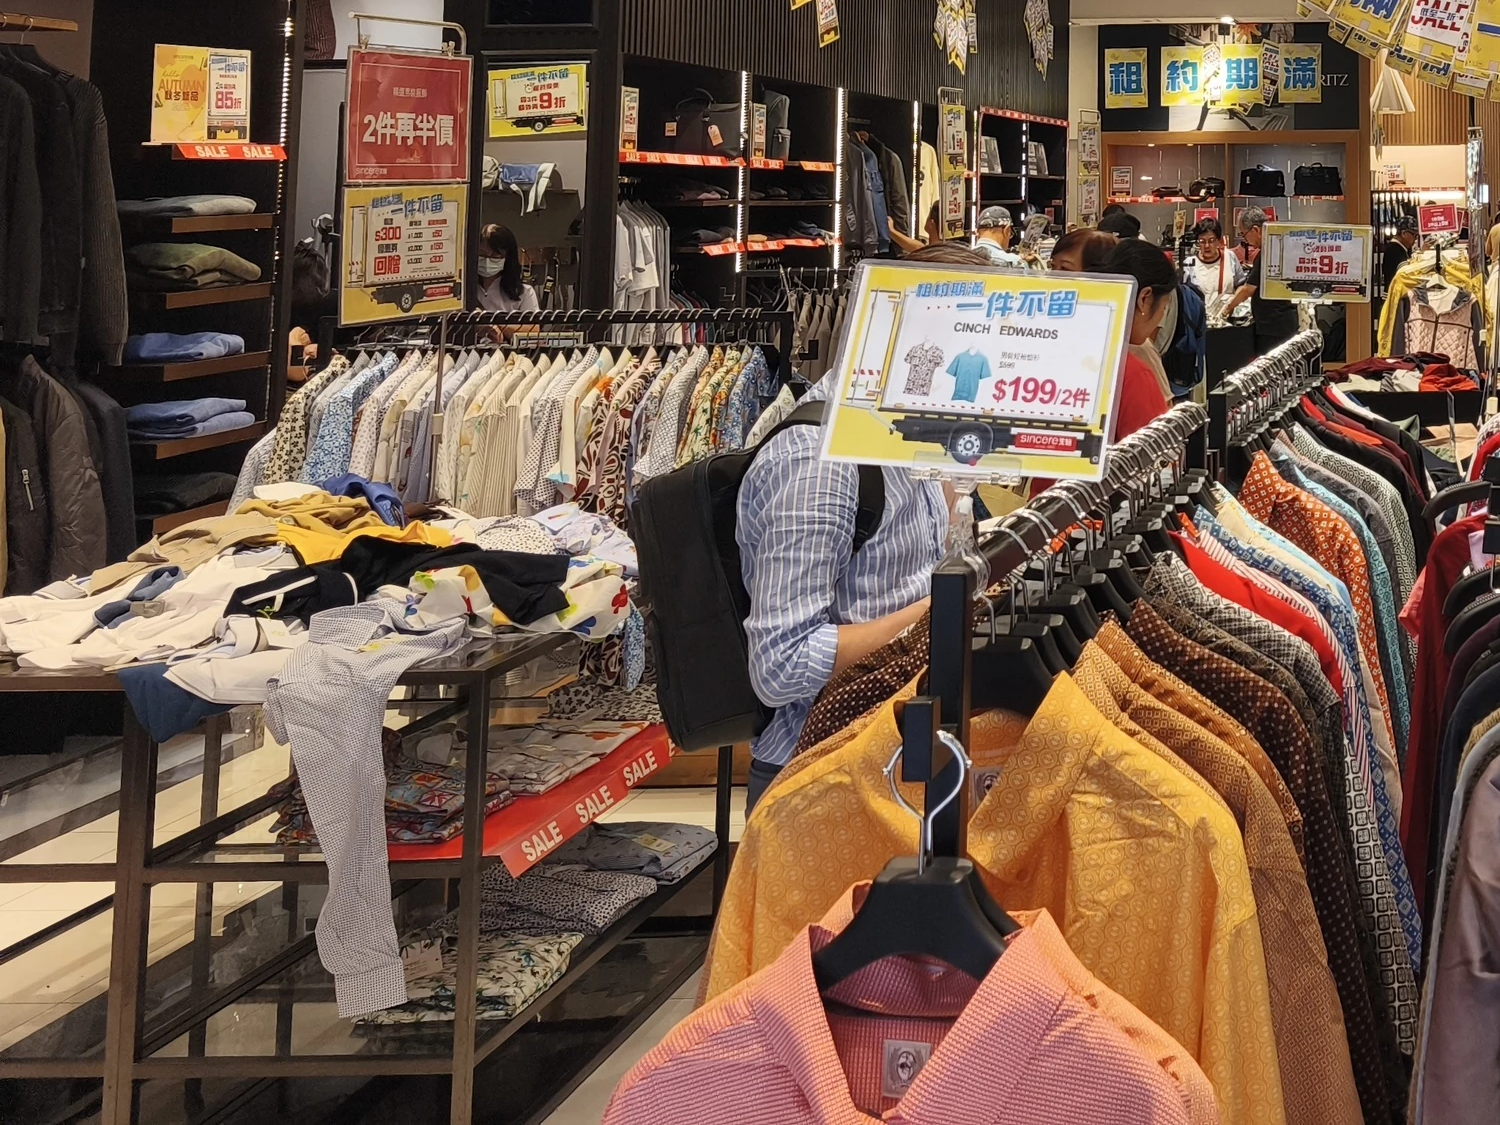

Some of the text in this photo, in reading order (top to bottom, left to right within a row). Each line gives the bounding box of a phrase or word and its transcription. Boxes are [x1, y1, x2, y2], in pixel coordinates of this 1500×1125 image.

[158, 79, 206, 93] AUTUMN
[1109, 56, 1318, 96] 租約期滿
[362, 111, 455, 146] 2件再半價
[196, 146, 274, 158] SALE SALE
[391, 194, 443, 219] 一件不留
[915, 280, 986, 297] 租約期滿
[956, 290, 1080, 318] 一件不留
[953, 322, 1059, 340] CINCH EDWARDS
[623, 750, 658, 787] SALE
[575, 785, 615, 824] SALE
[521, 821, 564, 862] SALE
